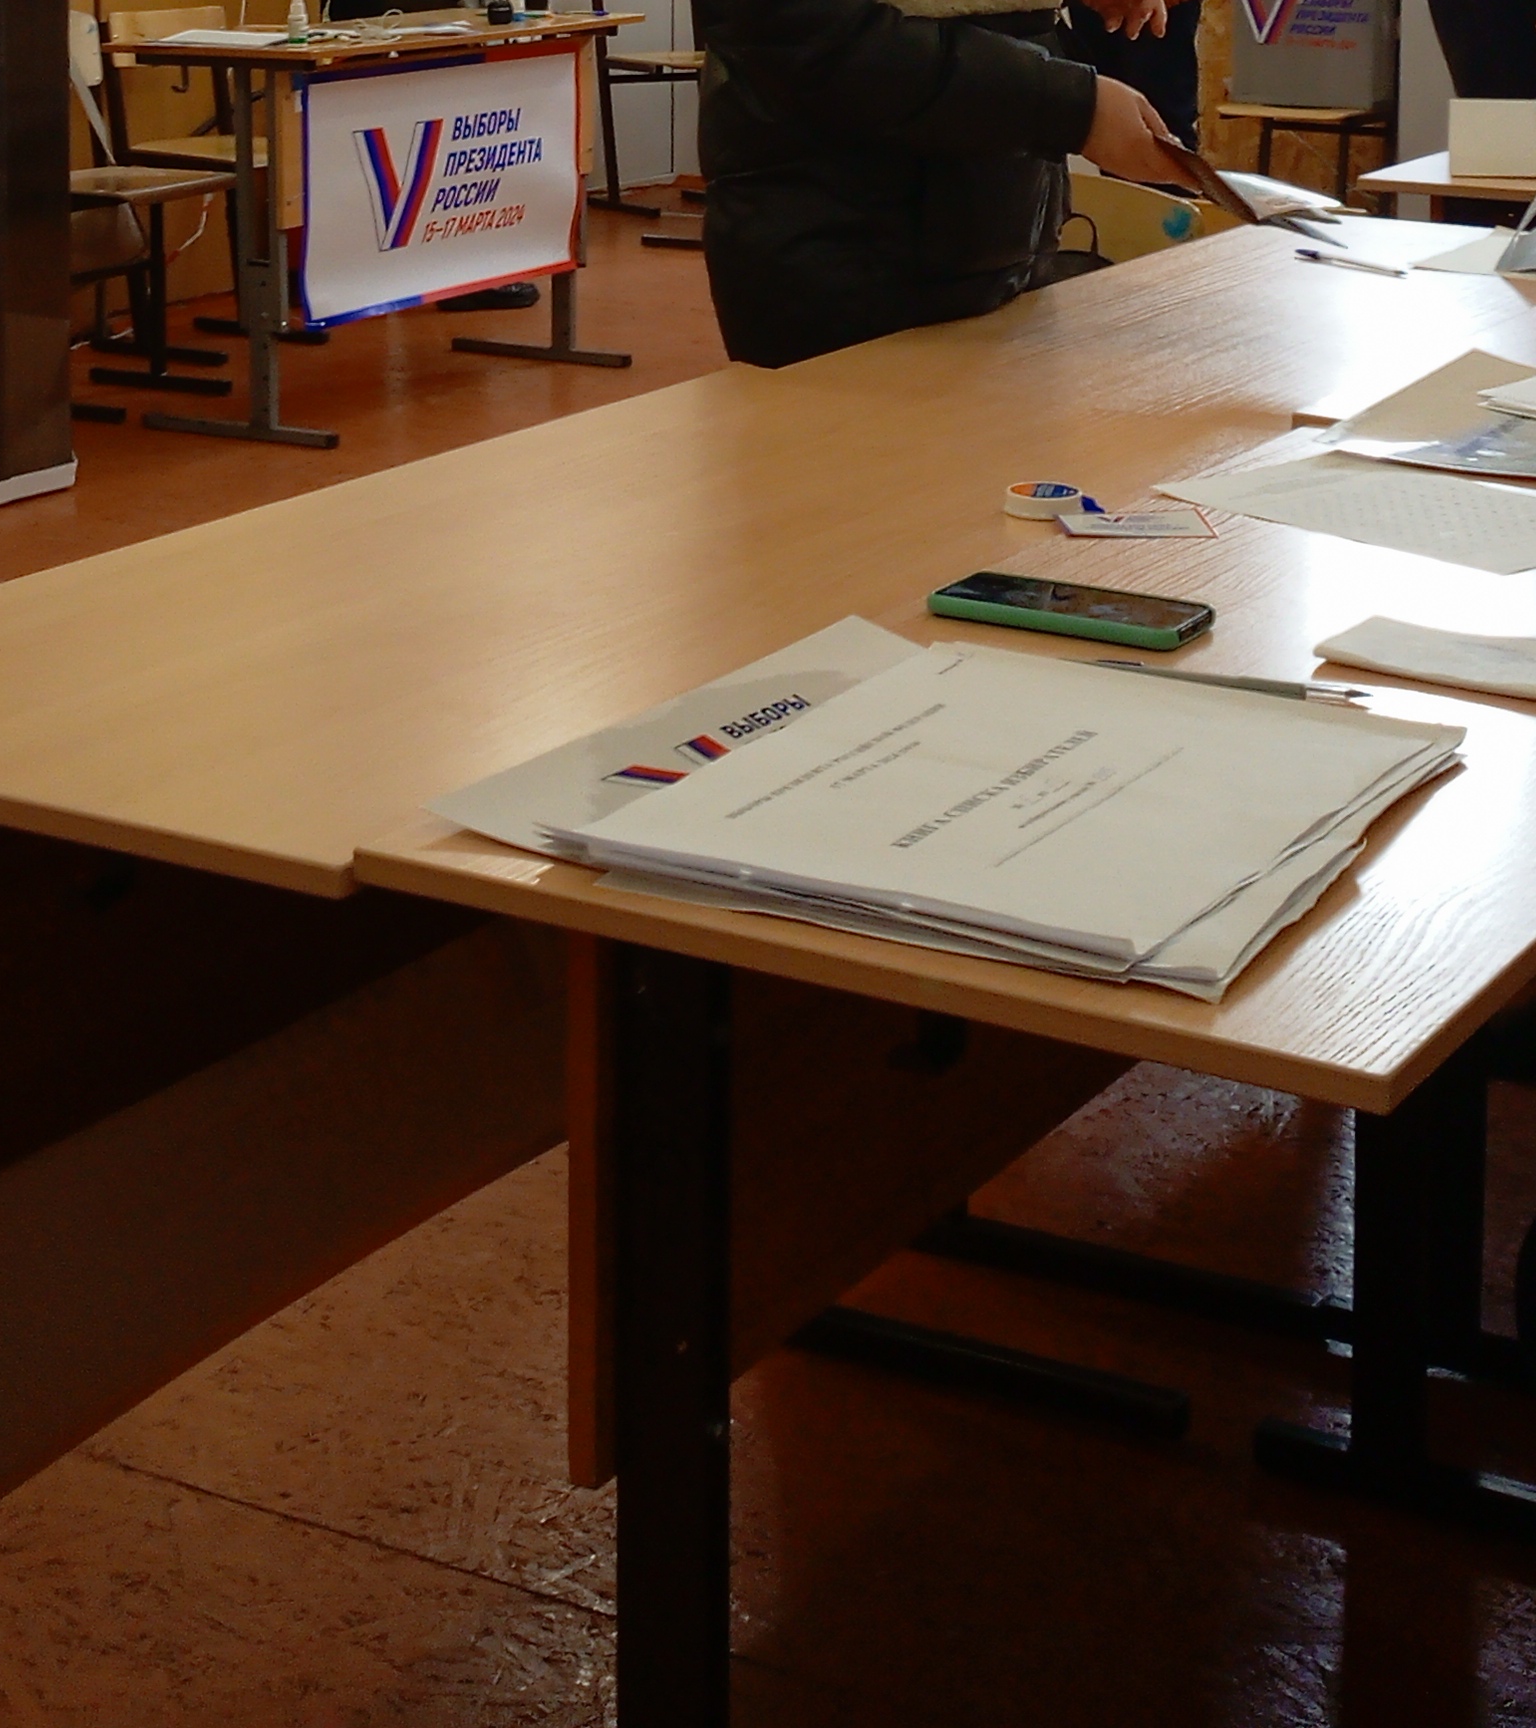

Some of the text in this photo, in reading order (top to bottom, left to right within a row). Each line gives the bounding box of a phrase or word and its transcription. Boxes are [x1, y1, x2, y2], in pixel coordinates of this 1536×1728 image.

[451, 108, 521, 141] ВЫБОРЫ
[443, 138, 543, 177] ПРЕЗИДЕНТА
[431, 178, 501, 214] РОССИИ
[454, 209, 494, 237] МАРТА
[493, 204, 526, 229] 2024
[720, 694, 812, 739] ВЫБОРЫ
